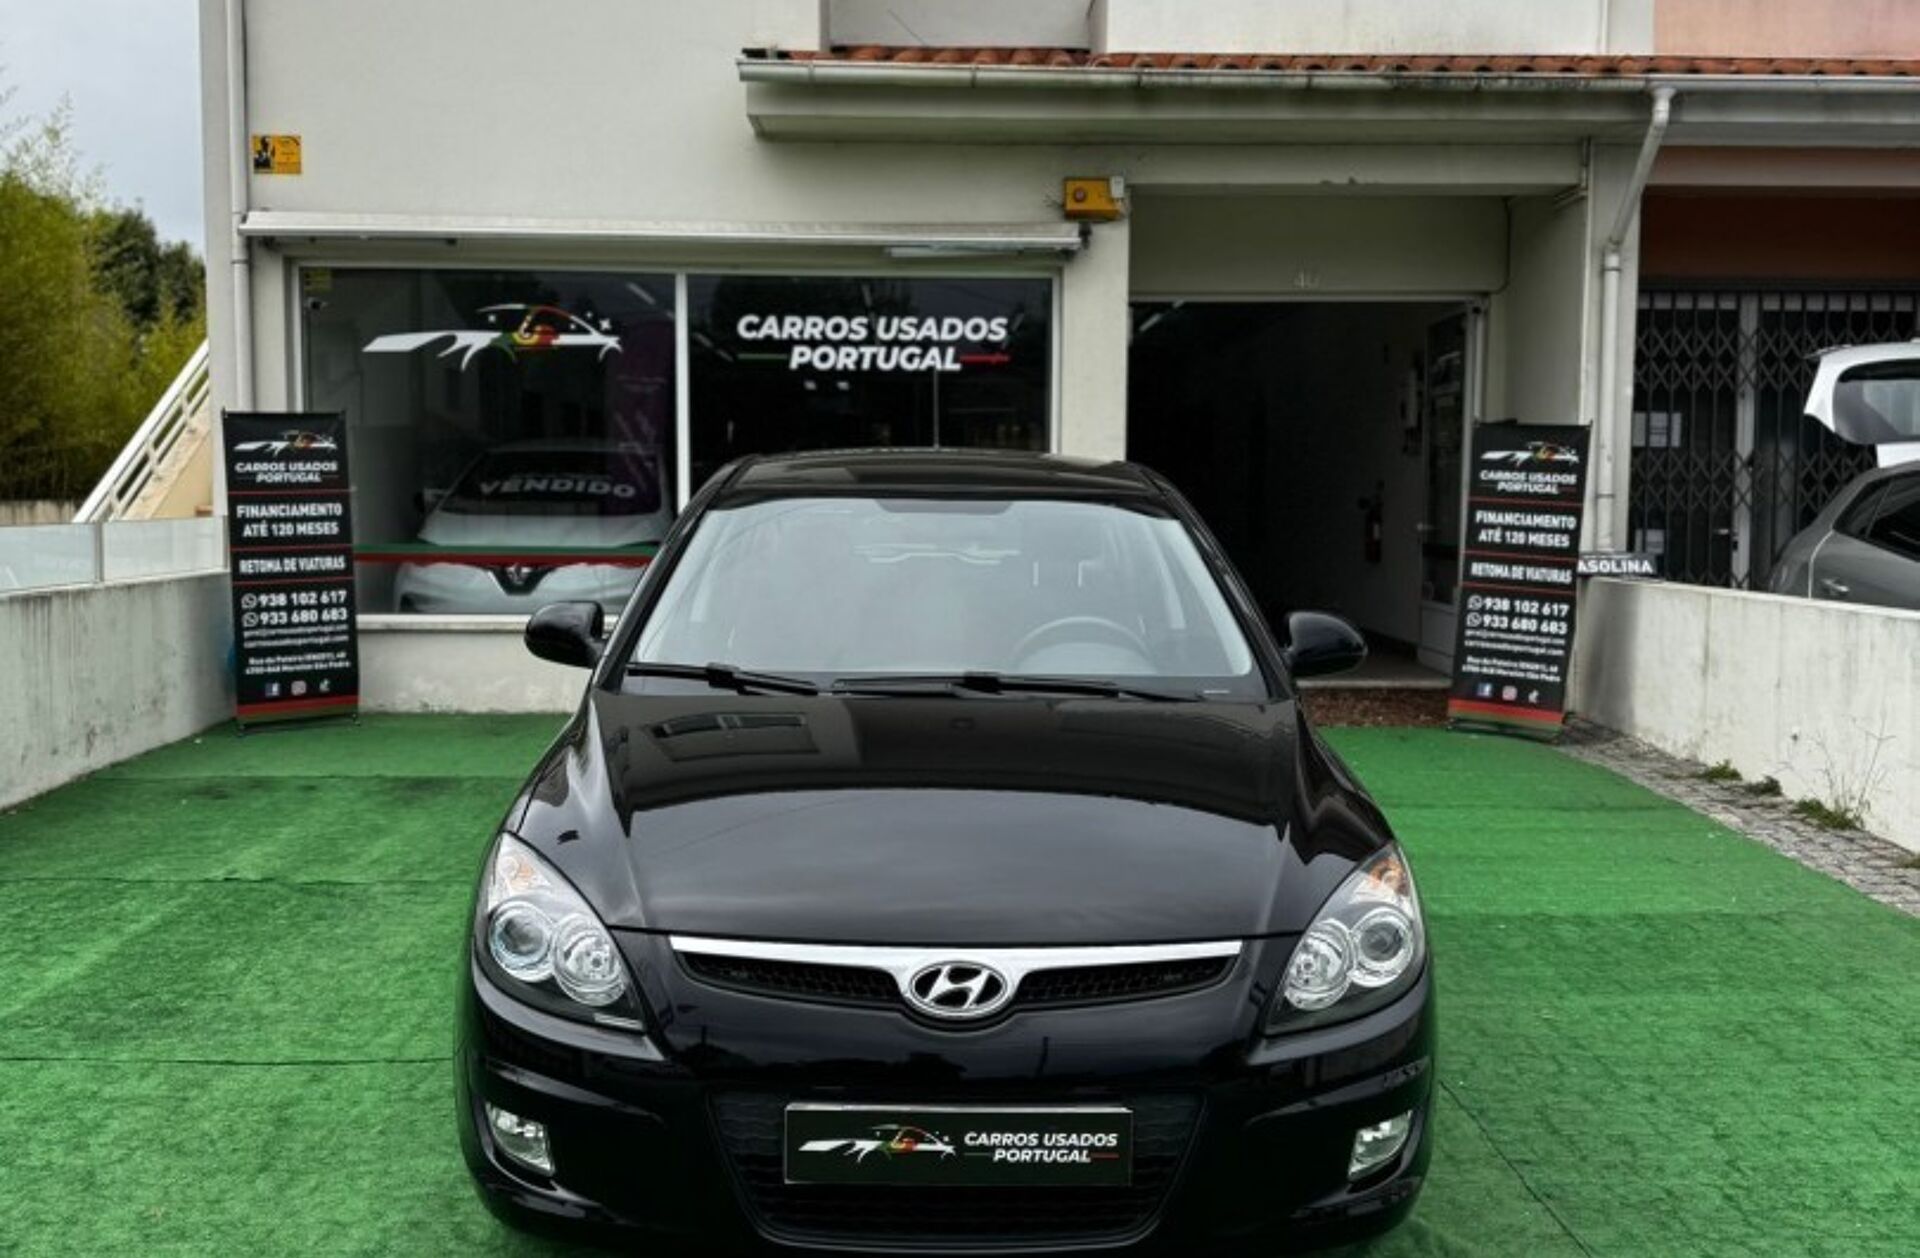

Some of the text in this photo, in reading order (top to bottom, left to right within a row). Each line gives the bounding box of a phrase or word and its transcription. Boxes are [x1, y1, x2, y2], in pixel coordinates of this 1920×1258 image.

[737, 315, 1008, 341] CARROS USADOS
[789, 346, 962, 370] PORTUGAL
[234, 461, 338, 472] CARROS USADOS
[256, 472, 322, 482] PORTUGAL
[1480, 470, 1577, 485] CARROS USADOS
[480, 478, 636, 497] VENDIDO
[1497, 482, 1559, 494] PORTUGAL
[236, 503, 343, 518] FINANCIAMENTO
[243, 520, 339, 537] ATÉ 120 MESES
[1476, 510, 1577, 530] FINANCIAMENTO
[1478, 527, 1570, 548] ATÉ 120 MESES
[239, 555, 346, 574] RETOMA DE VIATURAS
[1471, 562, 1572, 584] RETOMA DE VIATURAS
[1577, 560, 1654, 573] ASOLINA
[258, 590, 347, 607] 938 102 617
[1483, 597, 1570, 617] 938 102 617
[260, 607, 348, 625] 933 680 683
[1483, 614, 1567, 635] 933 680 683
[964, 1132, 1118, 1147] CARROS USADOS
[993, 1148, 1092, 1163] PORTUGAL
